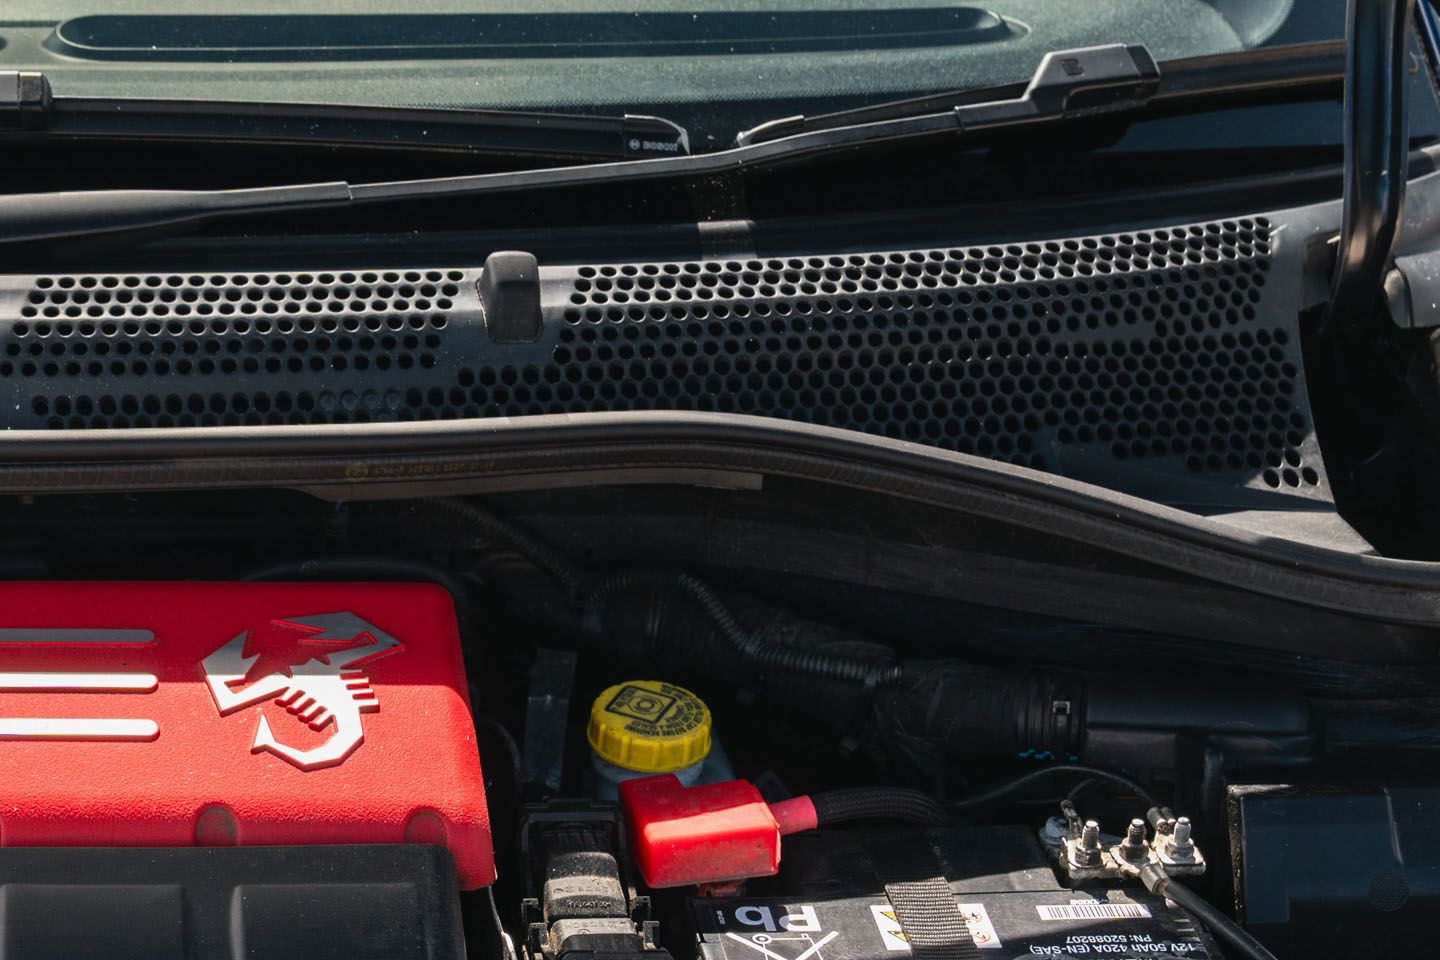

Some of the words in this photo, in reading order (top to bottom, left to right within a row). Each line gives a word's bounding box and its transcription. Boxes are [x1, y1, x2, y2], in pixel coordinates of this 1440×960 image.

[734, 905, 822, 932] Pb
[1066, 935, 1128, 943] 52088207
[1130, 934, 1152, 943] PN:
[1029, 943, 1090, 955] (EN-SAE)
[1092, 943, 1128, 953] 420A
[1131, 943, 1168, 953] 50Ah
[1171, 942, 1196, 952] 12V
